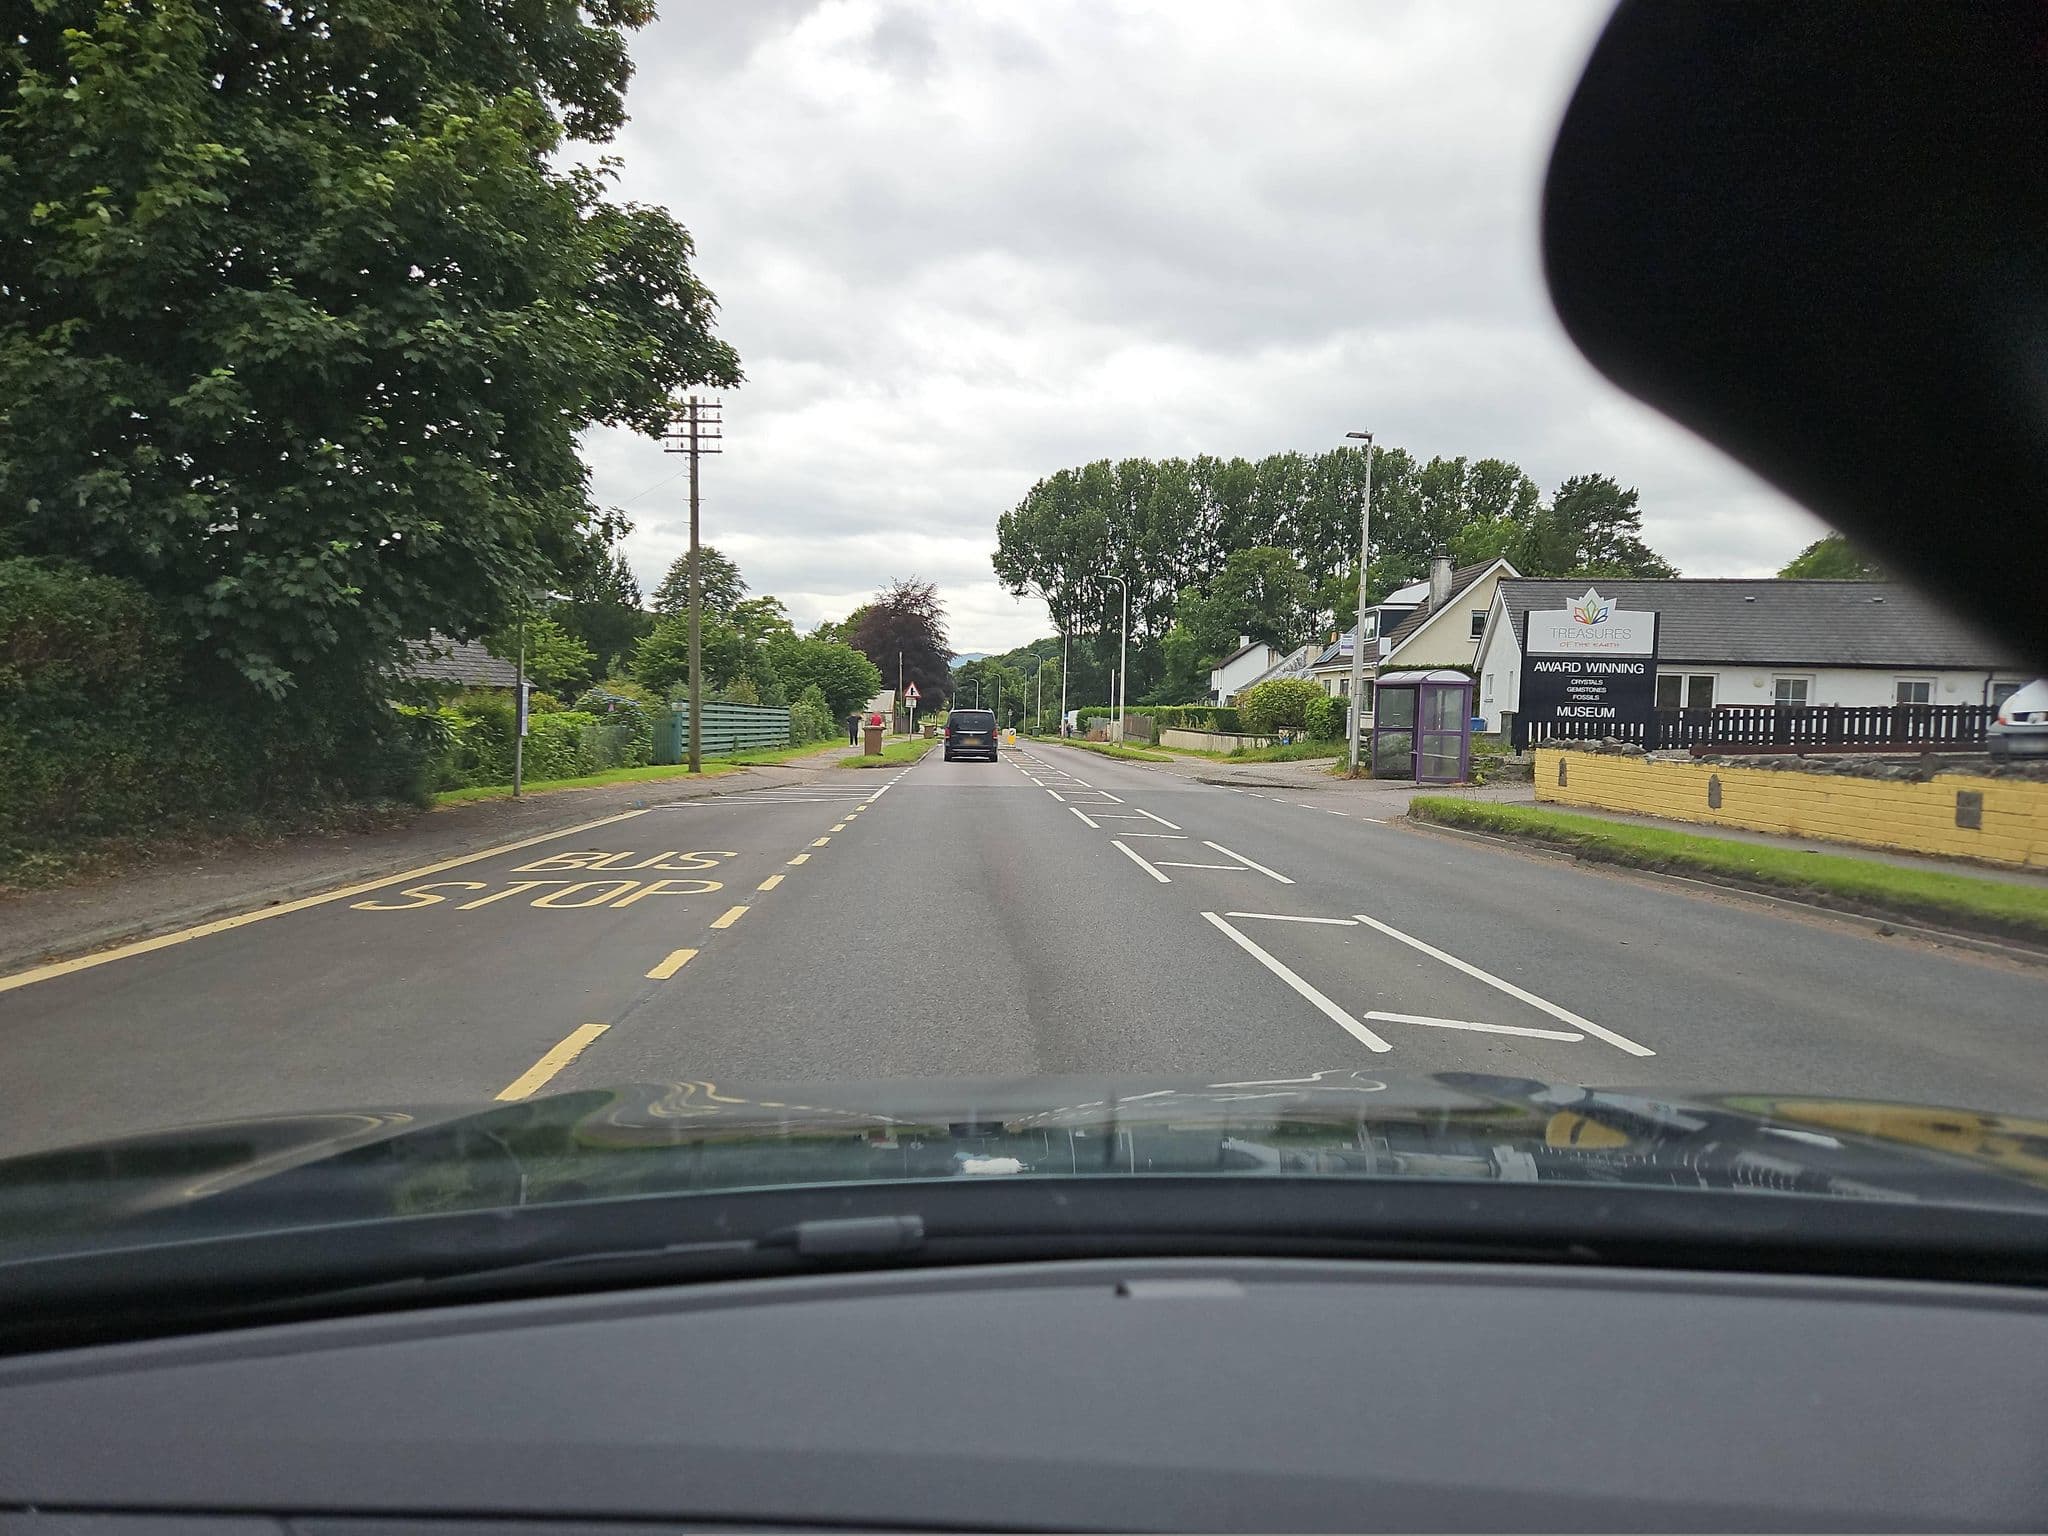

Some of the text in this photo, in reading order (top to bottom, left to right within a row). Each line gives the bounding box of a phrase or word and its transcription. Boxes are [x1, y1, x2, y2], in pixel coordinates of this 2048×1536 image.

[1550, 627, 1632, 640] TREASURES
[1534, 661, 1645, 674] AWARD WINNING
[1570, 678, 1604, 686] CRYSTALS
[1556, 706, 1616, 718] MUSEUM
[510, 851, 738, 872] BUS
[350, 880, 724, 910] STOP
